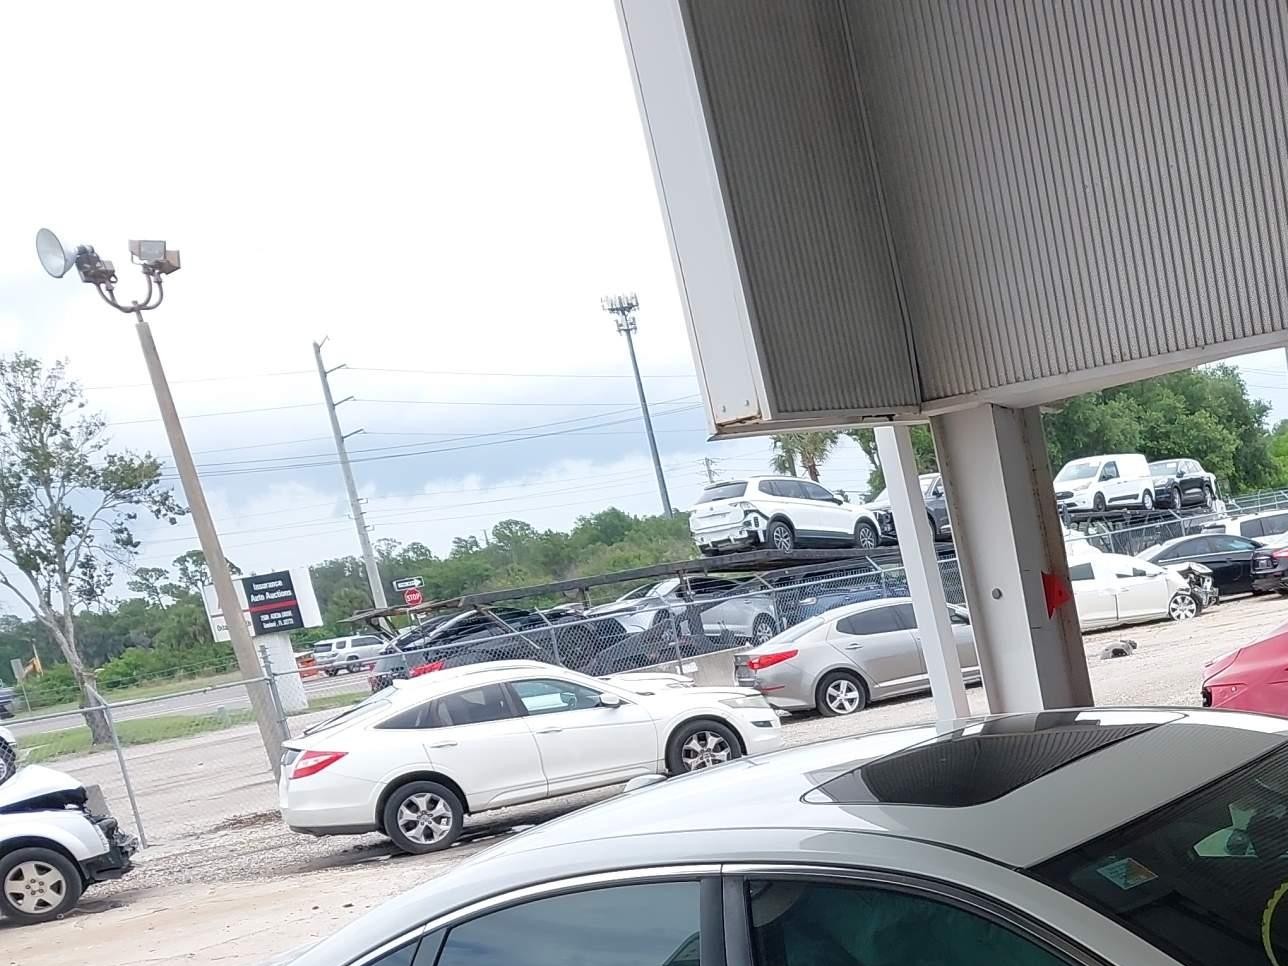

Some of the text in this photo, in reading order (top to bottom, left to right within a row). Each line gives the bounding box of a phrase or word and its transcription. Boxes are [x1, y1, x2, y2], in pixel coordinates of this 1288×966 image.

[252, 580, 283, 591] Insurance
[250, 589, 292, 602] Auto Auctions
[406, 593, 421, 602] STOP
